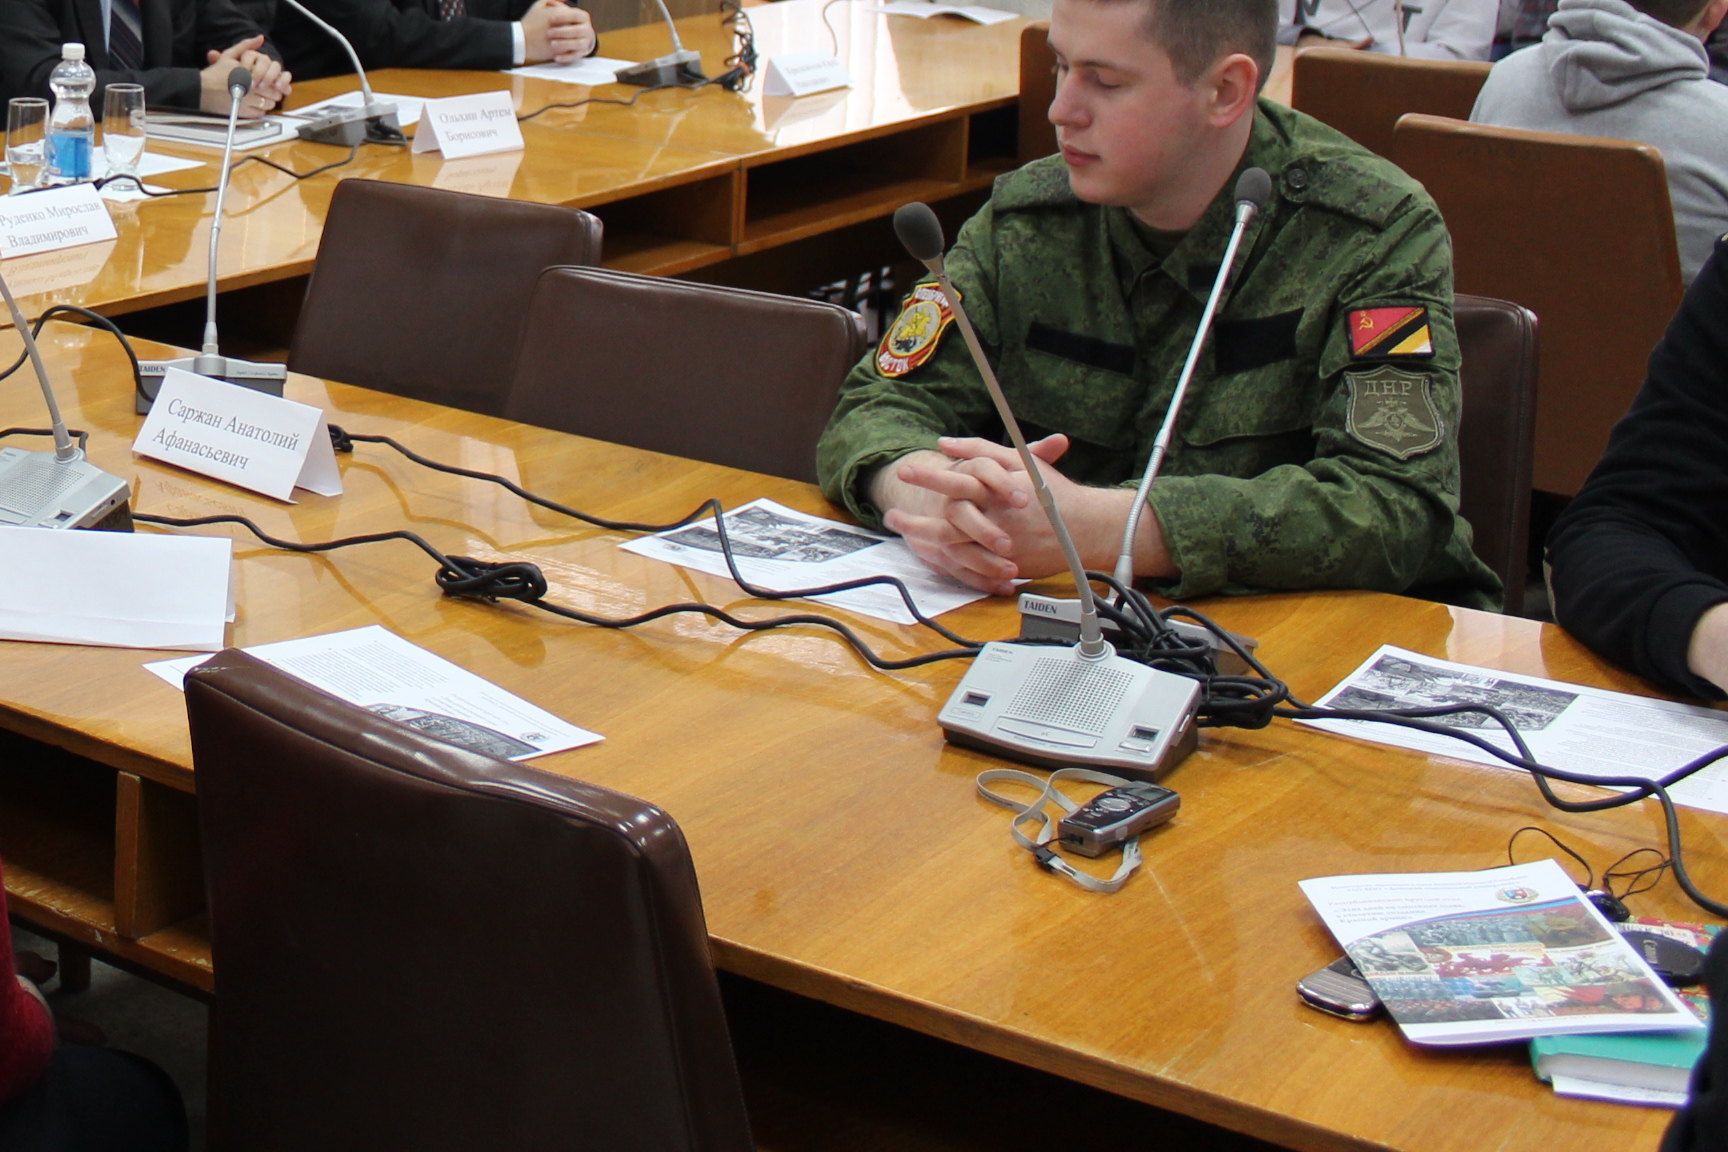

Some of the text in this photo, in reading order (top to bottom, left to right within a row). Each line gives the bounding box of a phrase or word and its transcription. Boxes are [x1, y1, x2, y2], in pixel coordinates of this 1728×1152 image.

[1394, 3, 1423, 34] T
[439, 107, 512, 124] Ольхин Артем
[45, 201, 101, 220] Мирослав
[7, 226, 89, 248] Владимирович
[139, 365, 166, 373] TAIDEN
[1364, 379, 1413, 397] ДНР
[168, 398, 301, 452] Саржан Анатолий
[152, 427, 250, 470] Афанасьевич
[1024, 600, 1057, 614] TAIDEN
